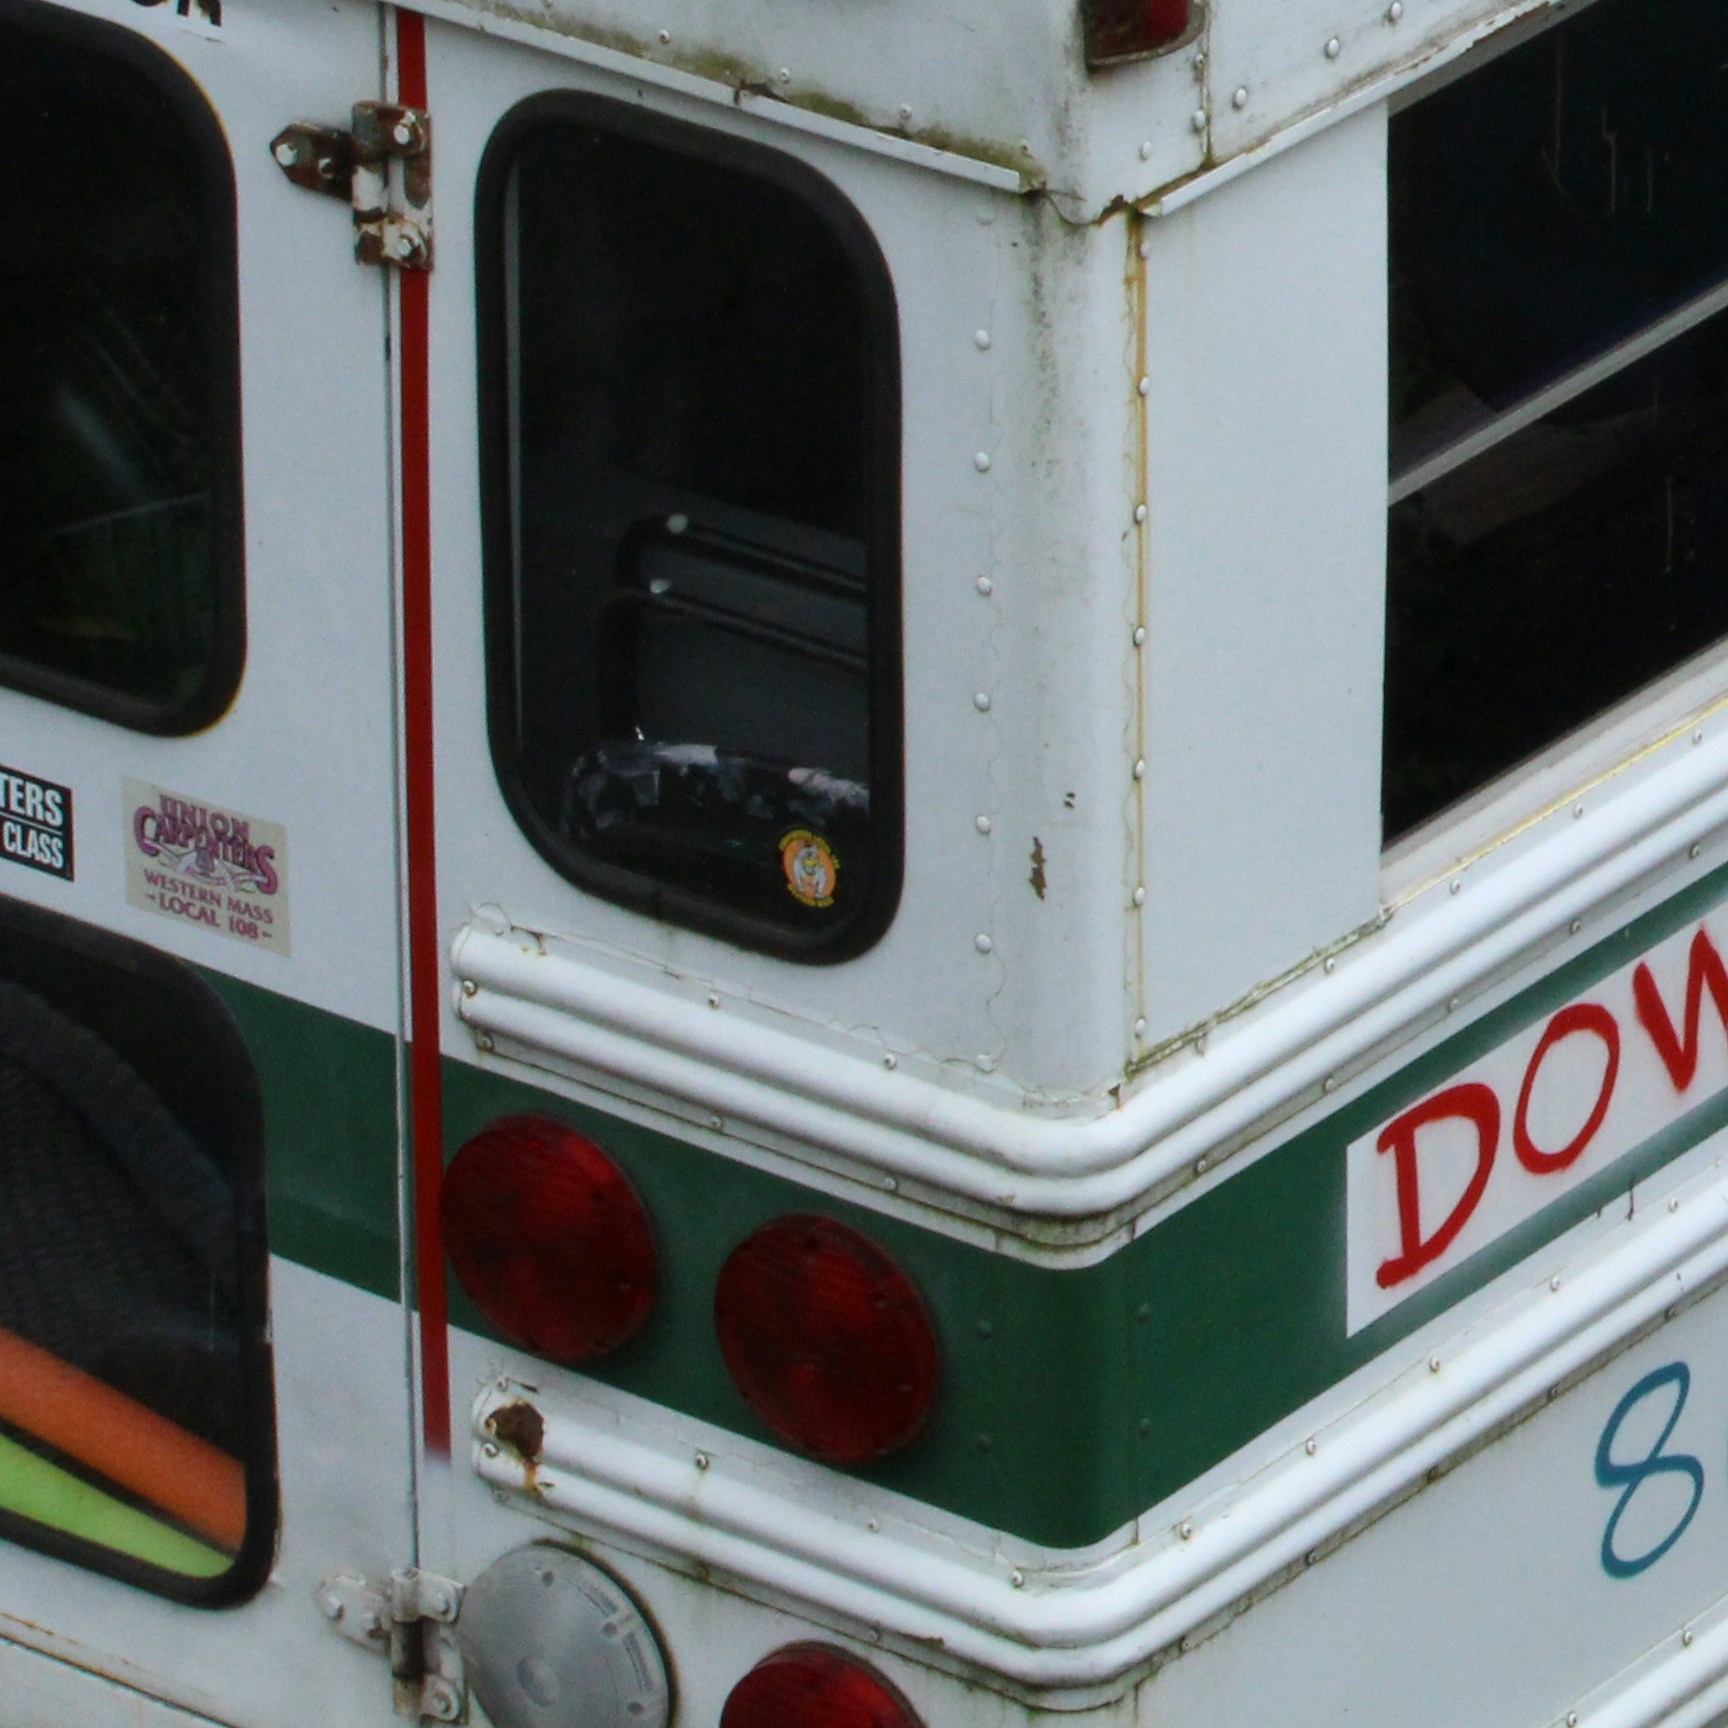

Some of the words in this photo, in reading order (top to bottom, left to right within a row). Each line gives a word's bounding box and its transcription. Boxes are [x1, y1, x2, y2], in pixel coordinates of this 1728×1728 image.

[3, 820, 64, 869] CLASS
[159, 794, 250, 845] UNION
[143, 869, 222, 908] WESTERN
[227, 895, 273, 924] MASS
